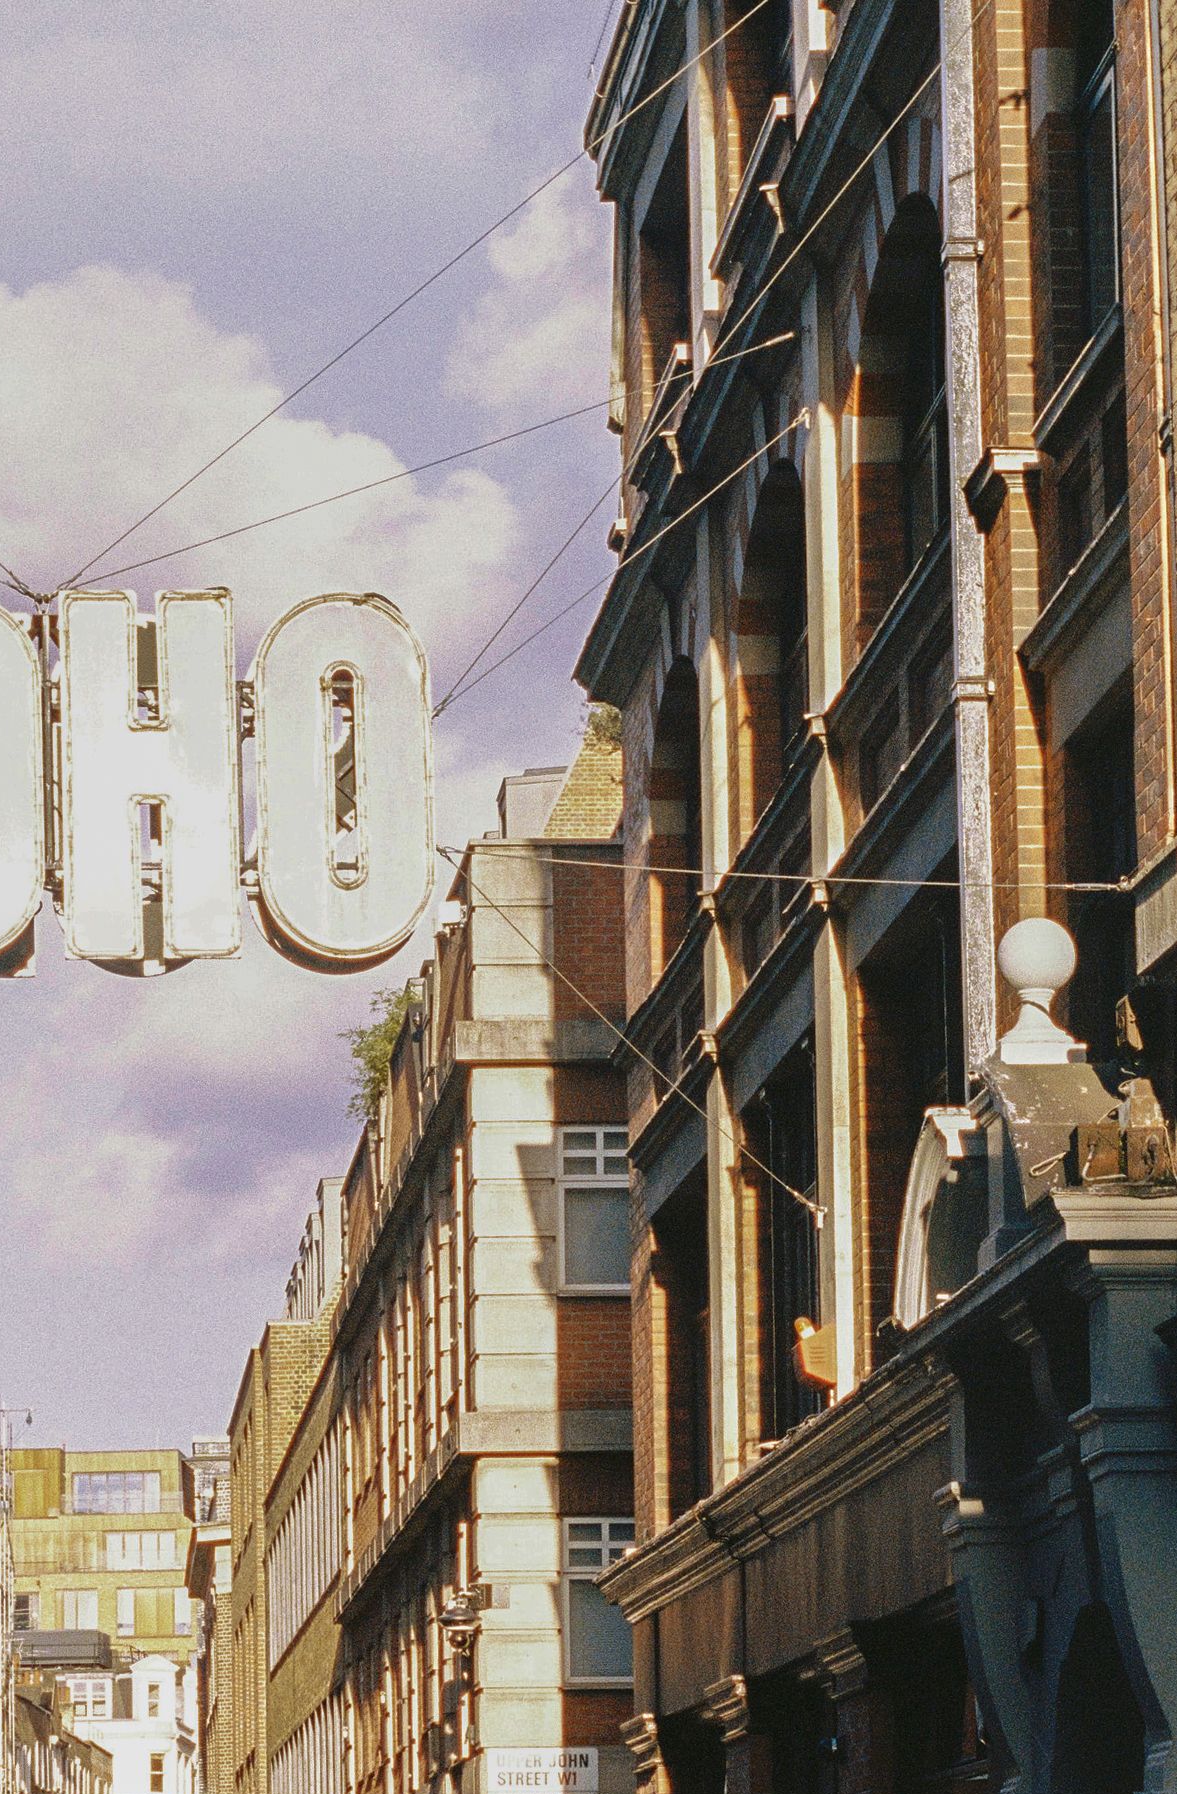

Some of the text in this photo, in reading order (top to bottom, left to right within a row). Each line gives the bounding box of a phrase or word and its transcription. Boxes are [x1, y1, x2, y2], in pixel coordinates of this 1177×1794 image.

[548, 1753, 590, 1769] JOHN
[497, 1771, 578, 1786] STREET W1
